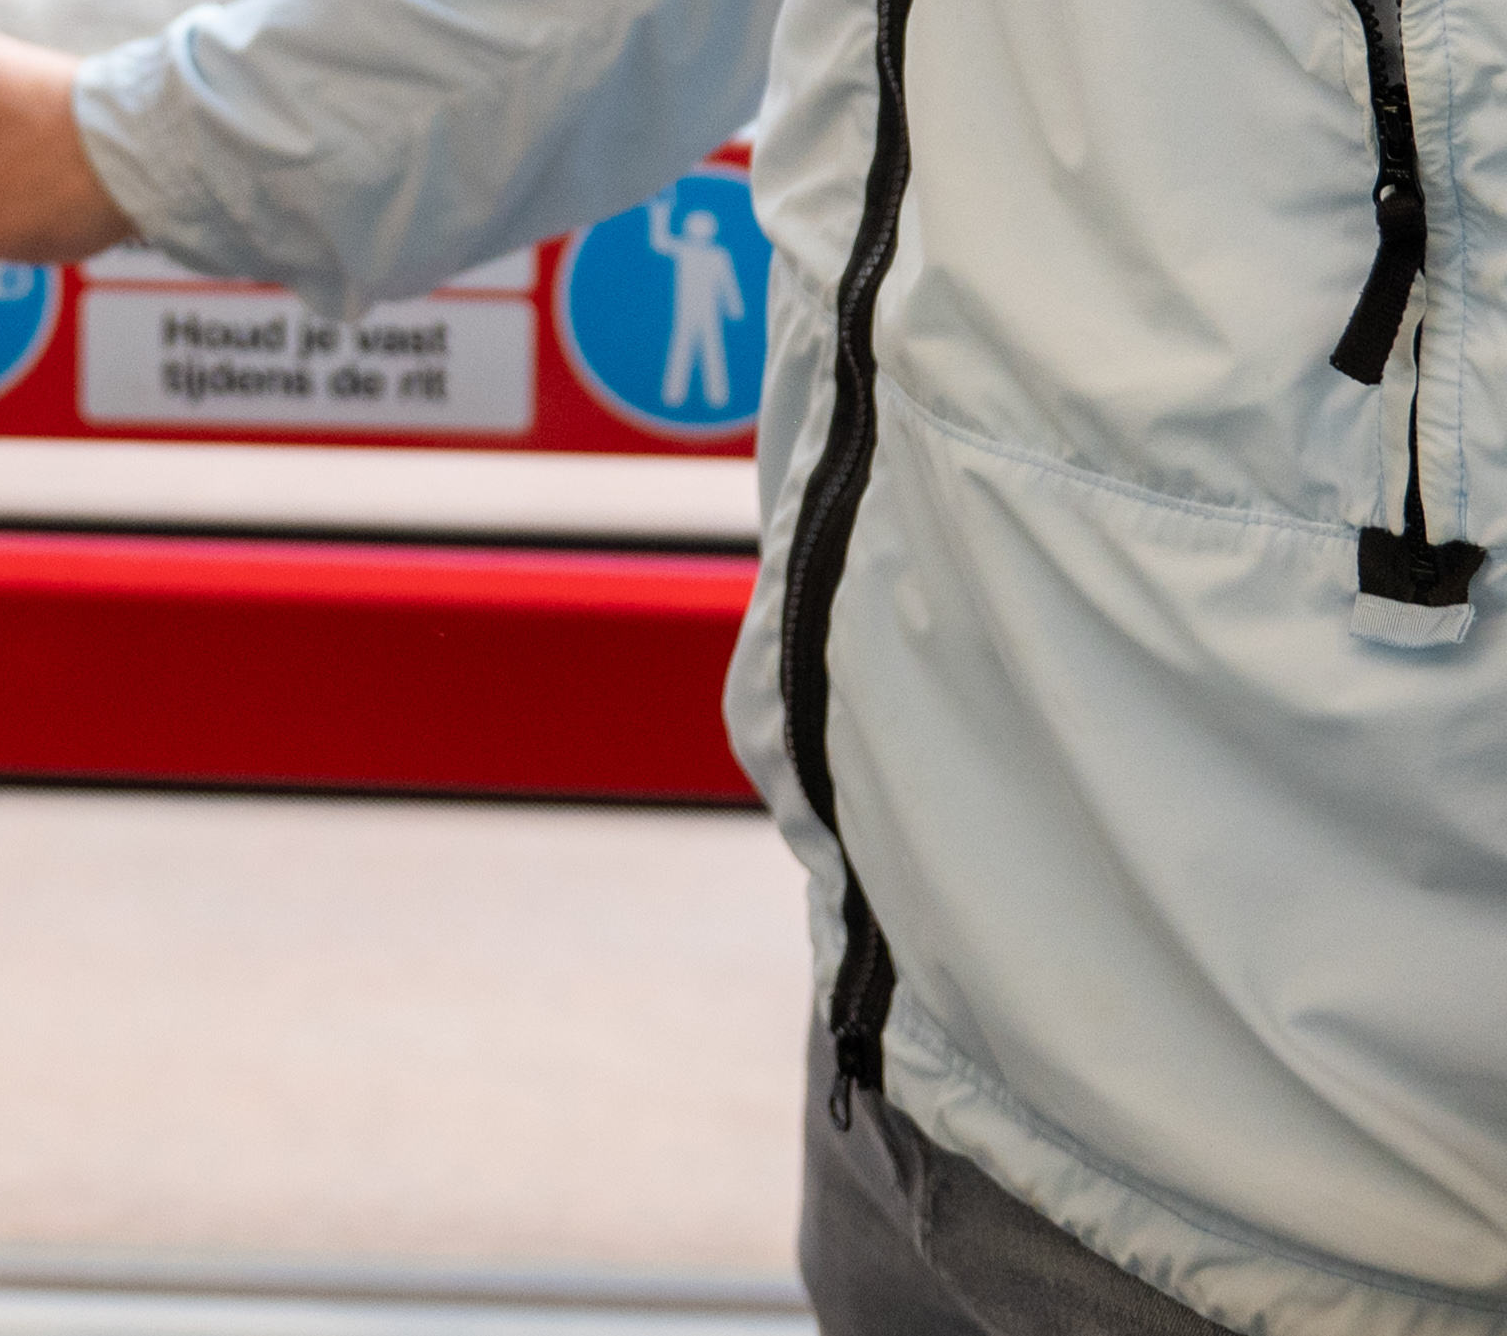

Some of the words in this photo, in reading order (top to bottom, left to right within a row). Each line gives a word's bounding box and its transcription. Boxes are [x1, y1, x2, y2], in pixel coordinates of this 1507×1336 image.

[163, 312, 284, 348] Houd
[300, 317, 336, 358] je
[358, 323, 447, 353] vast
[163, 361, 311, 402] tijdens
[330, 364, 383, 398] de
[400, 365, 447, 399] rit
